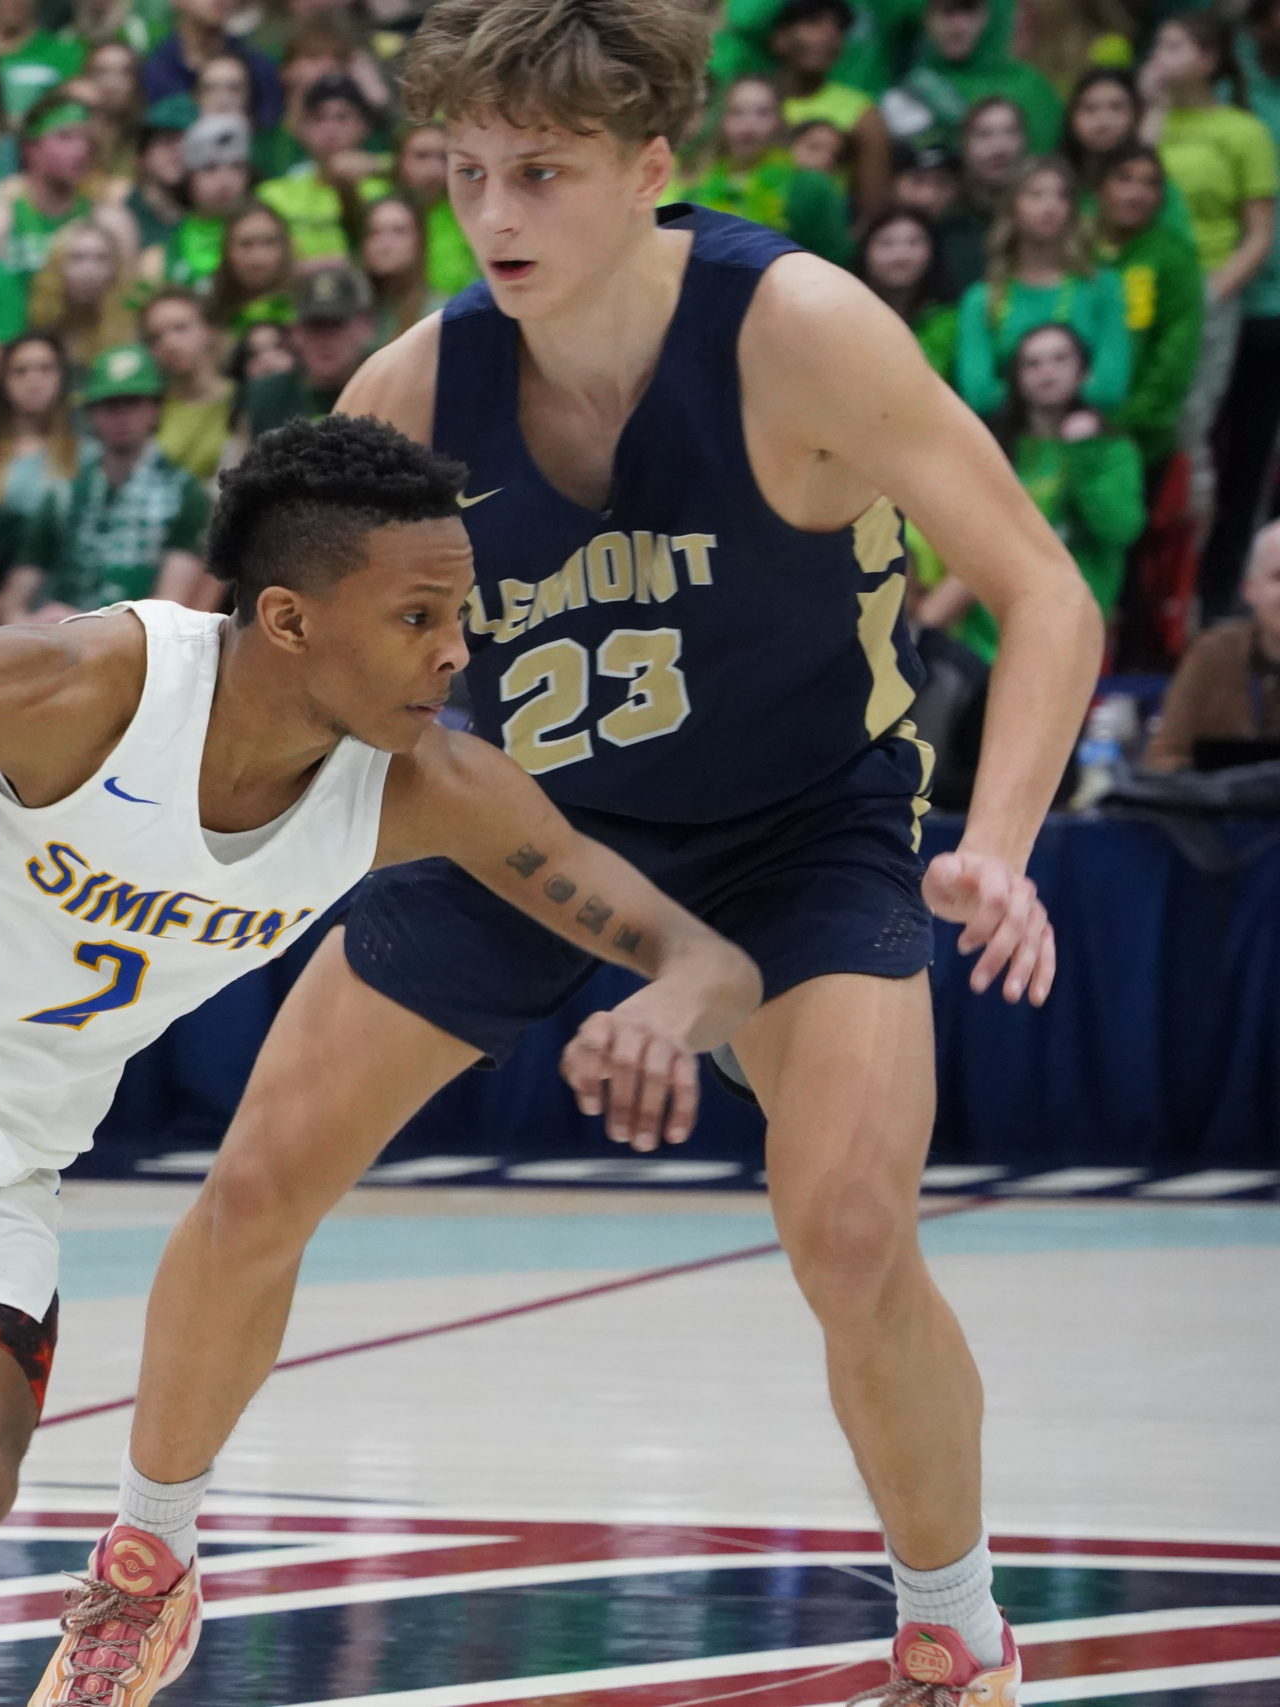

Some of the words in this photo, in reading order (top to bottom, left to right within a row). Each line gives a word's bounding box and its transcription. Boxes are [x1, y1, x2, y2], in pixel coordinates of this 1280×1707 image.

[466, 530, 717, 643] LEMONT
[500, 627, 692, 775] 23
[19, 939, 151, 1031] 2
